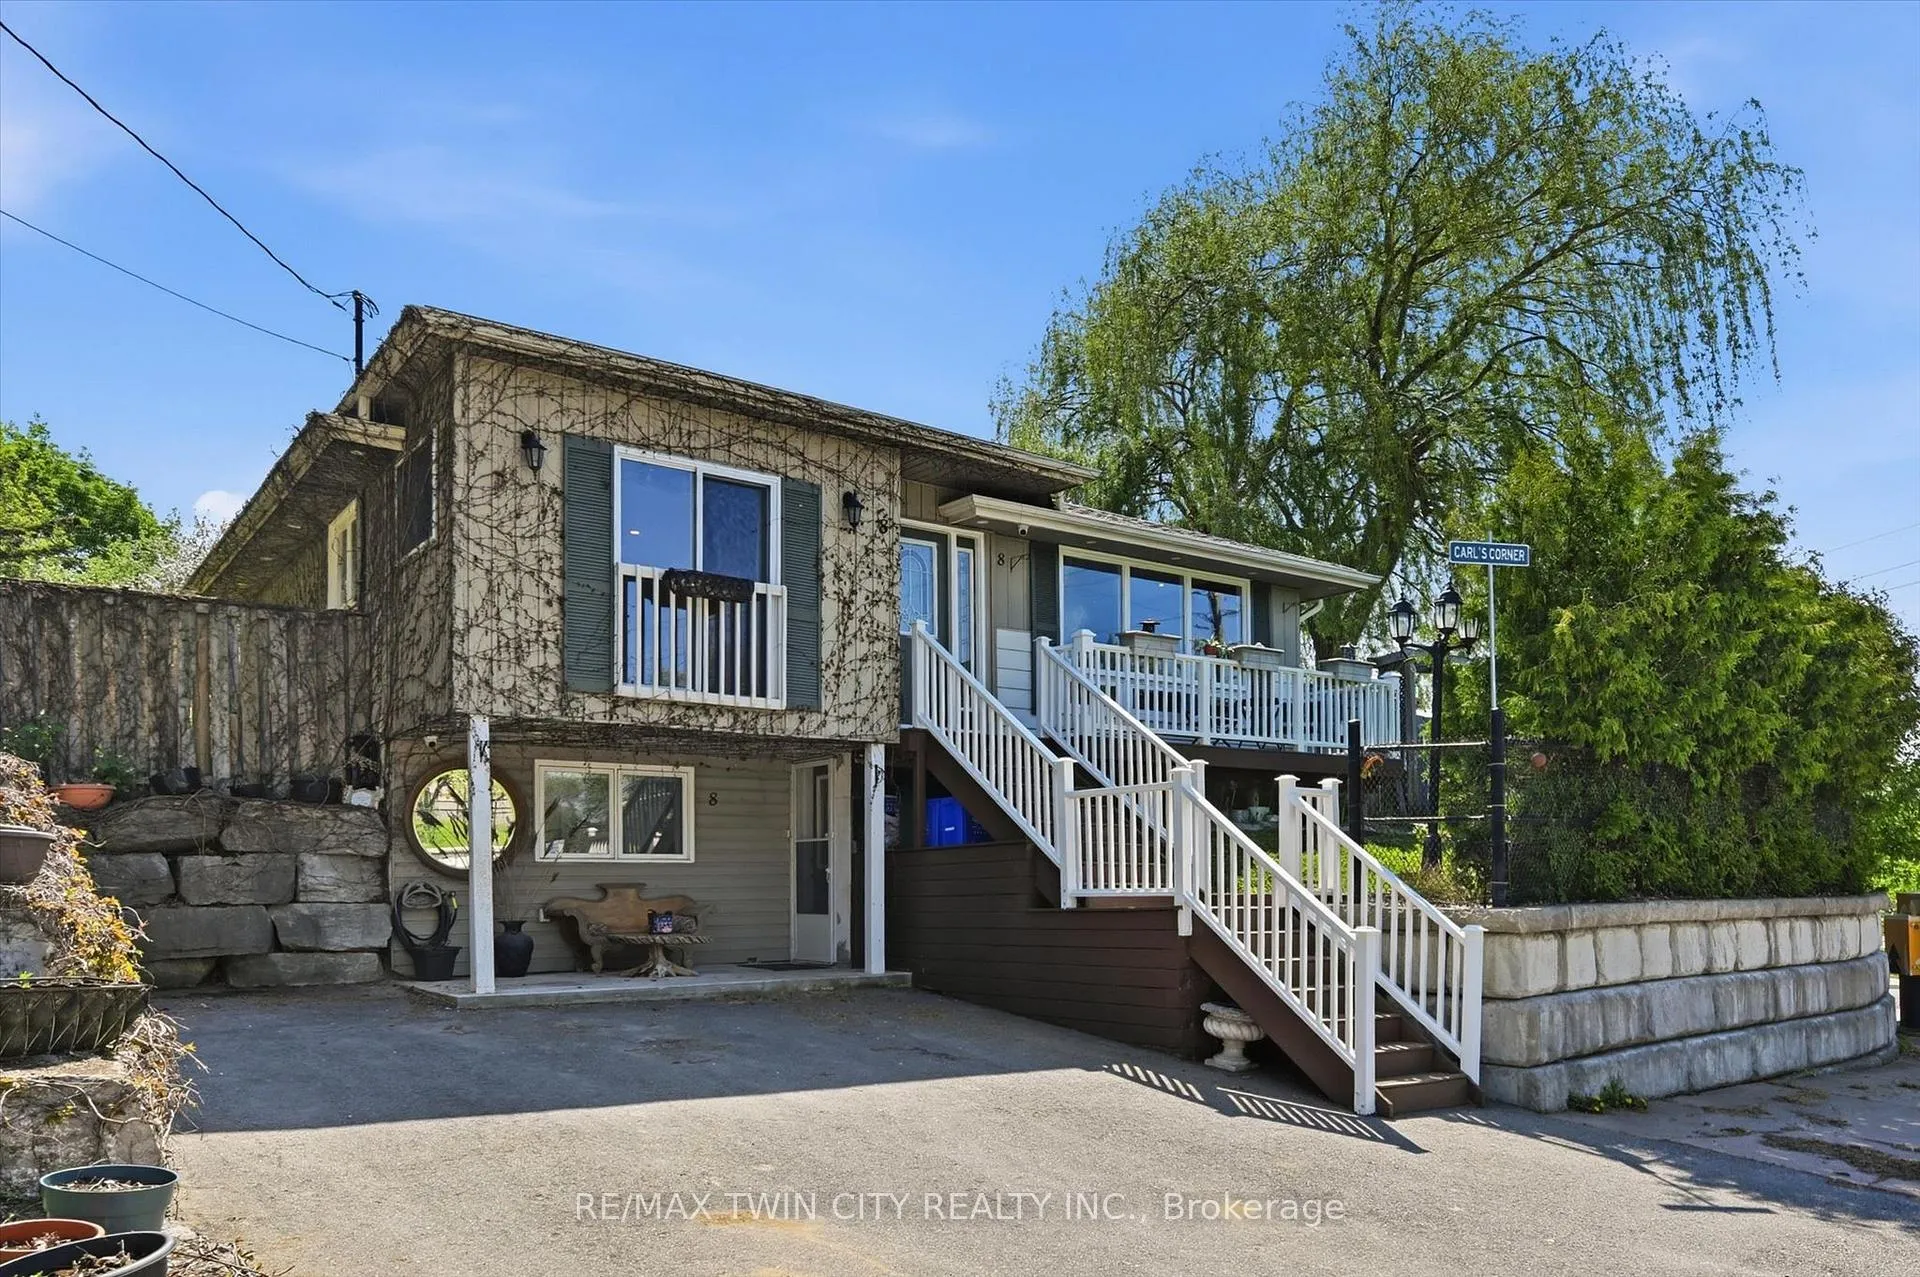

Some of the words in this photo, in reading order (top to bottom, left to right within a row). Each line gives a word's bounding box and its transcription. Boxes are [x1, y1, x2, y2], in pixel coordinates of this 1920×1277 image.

[879, 519, 888, 534] 8
[997, 553, 1005, 566] 8
[1454, 546, 1487, 559] CARL'S
[1489, 548, 1525, 561] CORNER
[709, 792, 718, 806] 8
